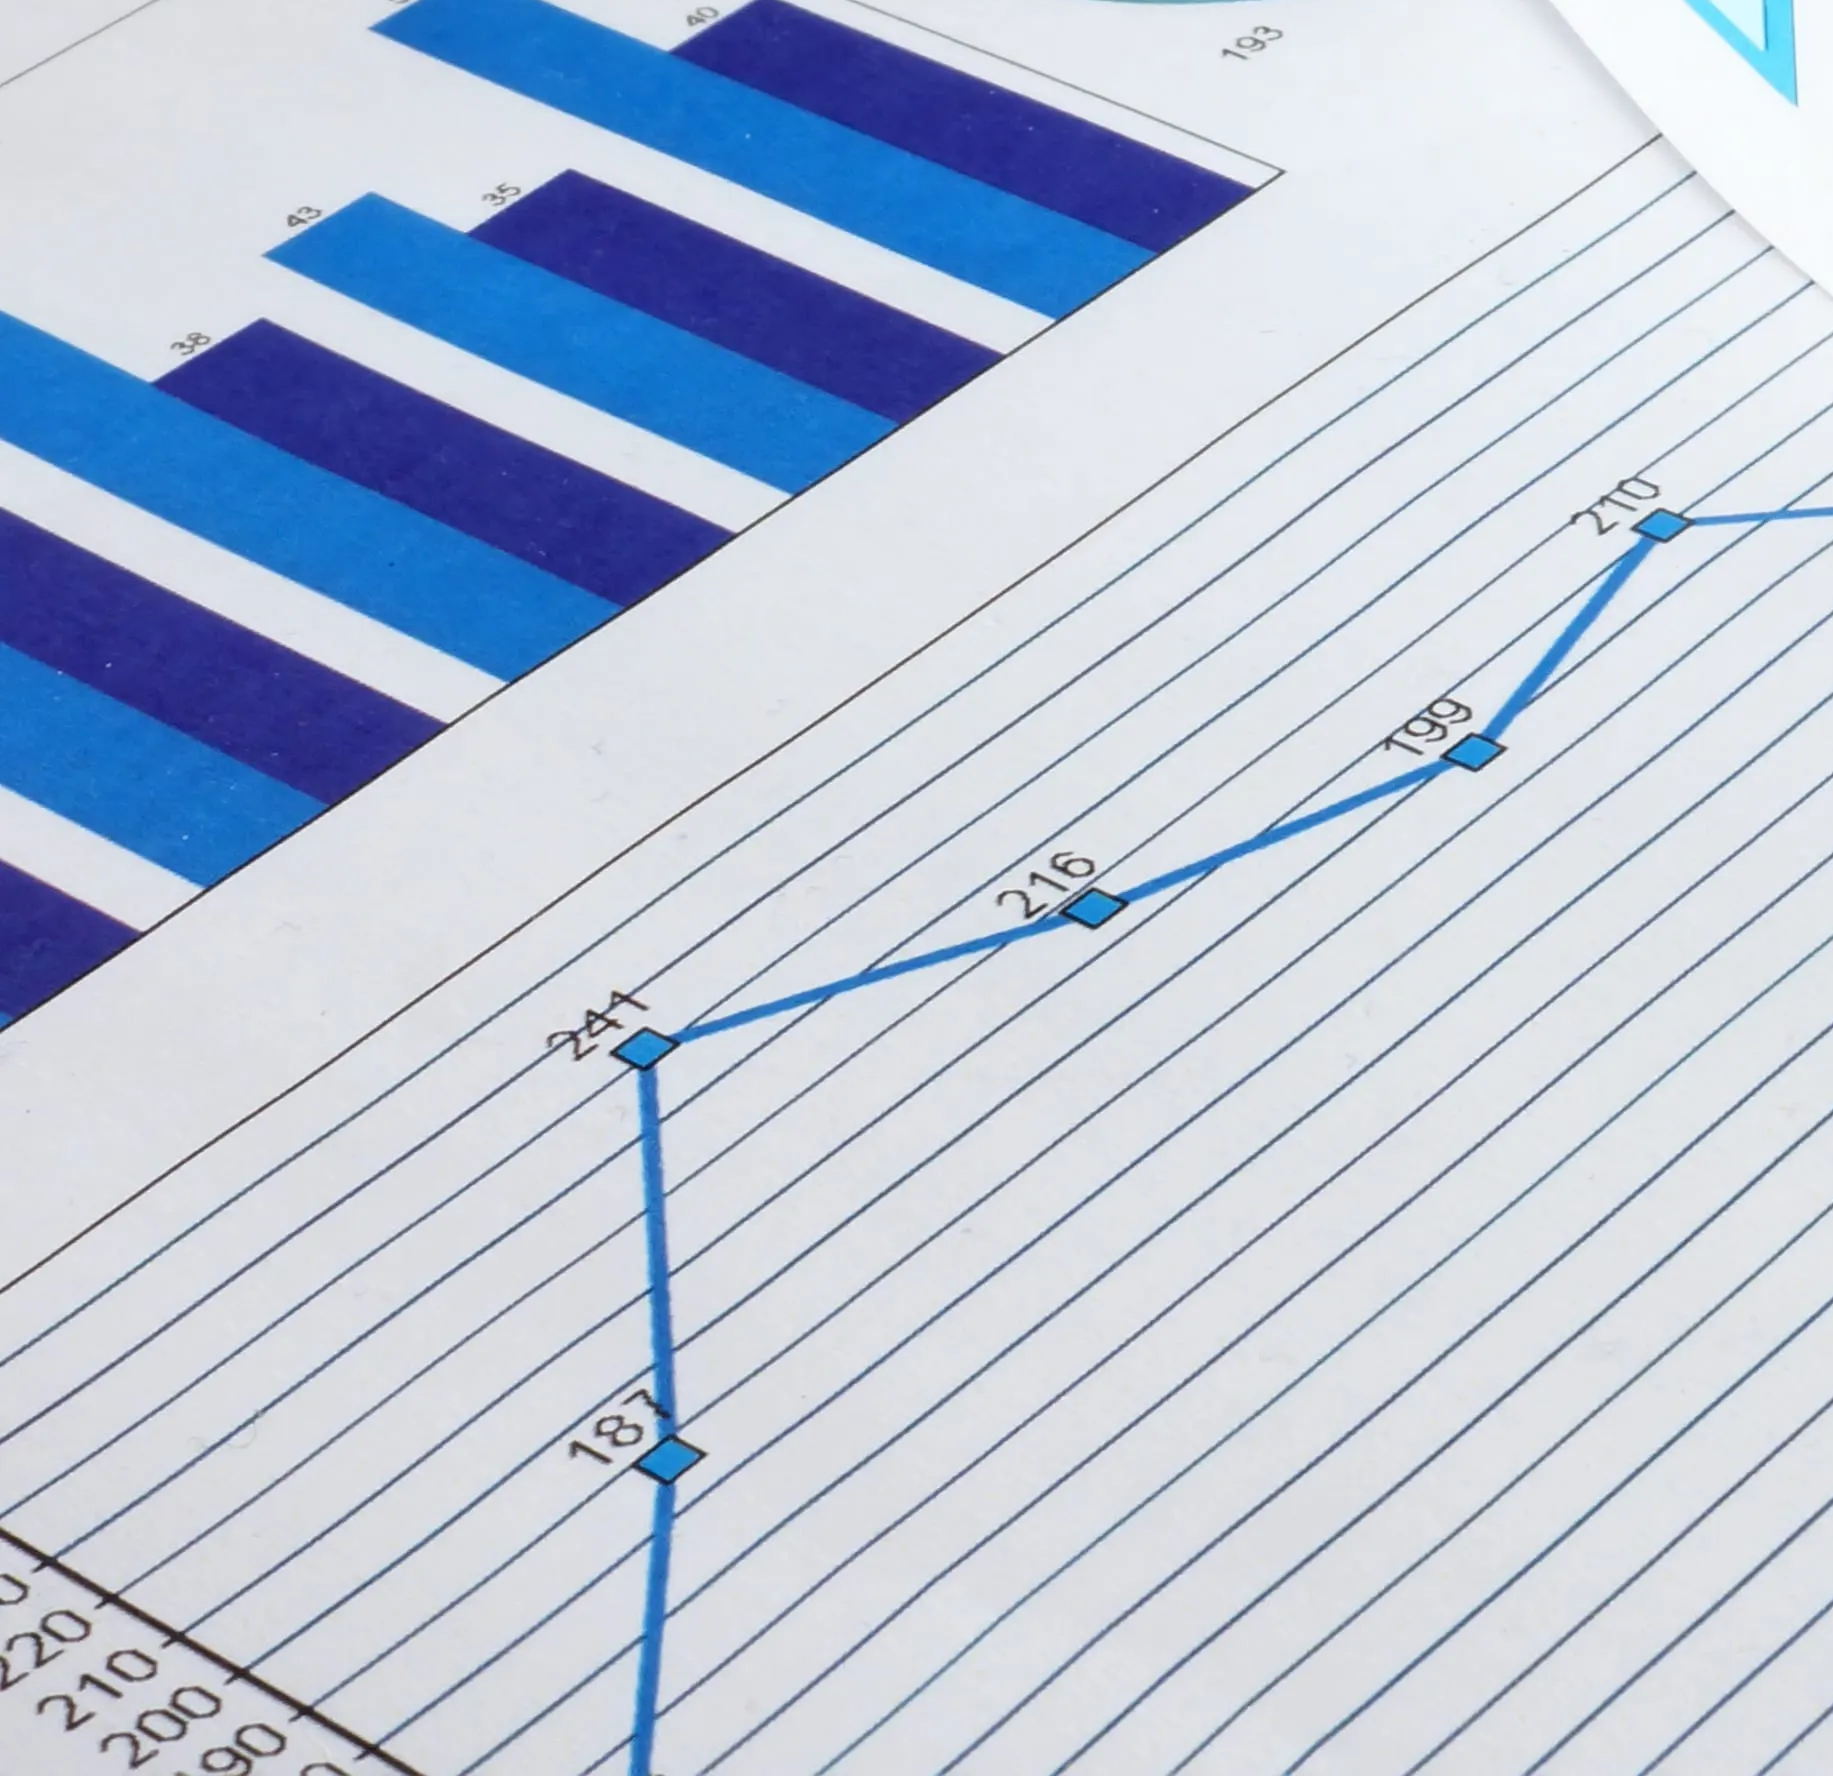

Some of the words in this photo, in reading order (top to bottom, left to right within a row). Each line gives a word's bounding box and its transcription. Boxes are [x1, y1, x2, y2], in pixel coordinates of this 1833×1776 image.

[685, 5, 720, 28] 40
[1220, 25, 1285, 61] 193
[286, 206, 323, 228] 43
[481, 182, 522, 207] 35
[170, 331, 212, 357] 38
[1570, 477, 1662, 536] 210
[1384, 696, 1474, 757] 199
[997, 850, 1097, 920] 216
[546, 989, 651, 1062] 241
[568, 1387, 672, 1466] 187
[36, 1649, 159, 1732] 210
[99, 1685, 223, 1771] 200
[173, 1722, 288, 1776] 90
